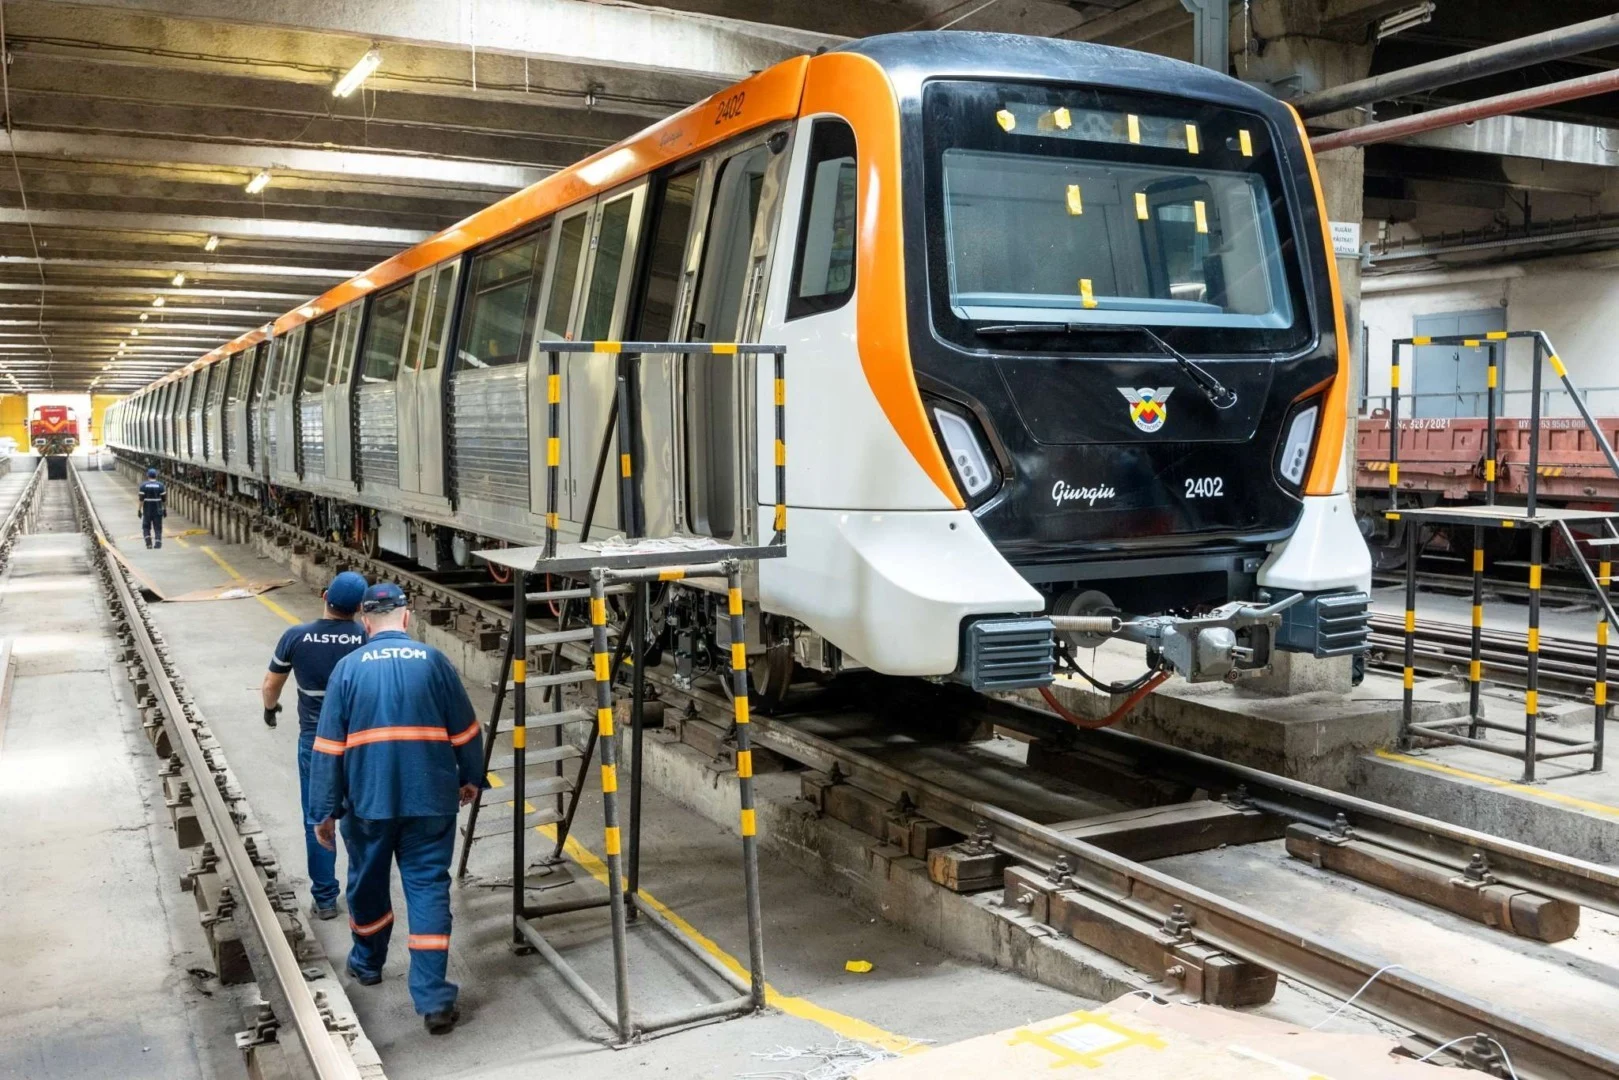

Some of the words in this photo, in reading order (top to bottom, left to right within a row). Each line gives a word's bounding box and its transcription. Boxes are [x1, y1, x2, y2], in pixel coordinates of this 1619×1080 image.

[714, 91, 746, 126] 2402
[1410, 418, 1451, 430] 328/2021
[1052, 480, 1116, 507] Giurgiu
[1184, 477, 1224, 499] 2402
[302, 632, 362, 645] ALSTOM
[361, 646, 427, 663] ALSTOM
